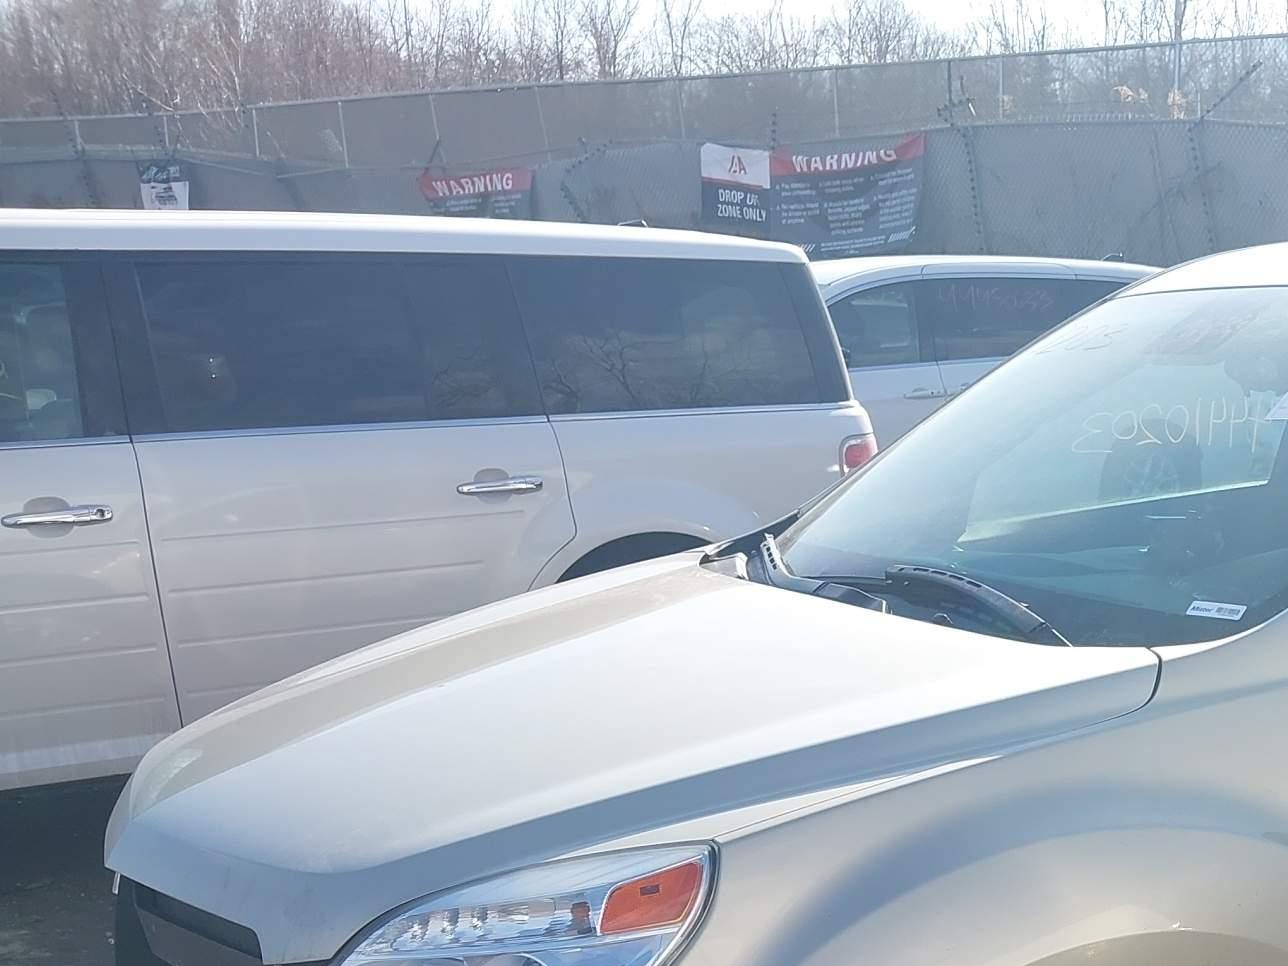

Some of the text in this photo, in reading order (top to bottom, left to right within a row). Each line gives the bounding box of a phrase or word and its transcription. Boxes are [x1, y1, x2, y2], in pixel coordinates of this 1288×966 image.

[792, 148, 897, 172] WARNING
[432, 173, 513, 197] WARNING
[718, 188, 744, 204] DROP
[717, 204, 742, 218] ZONE
[743, 206, 766, 222] ONLY
